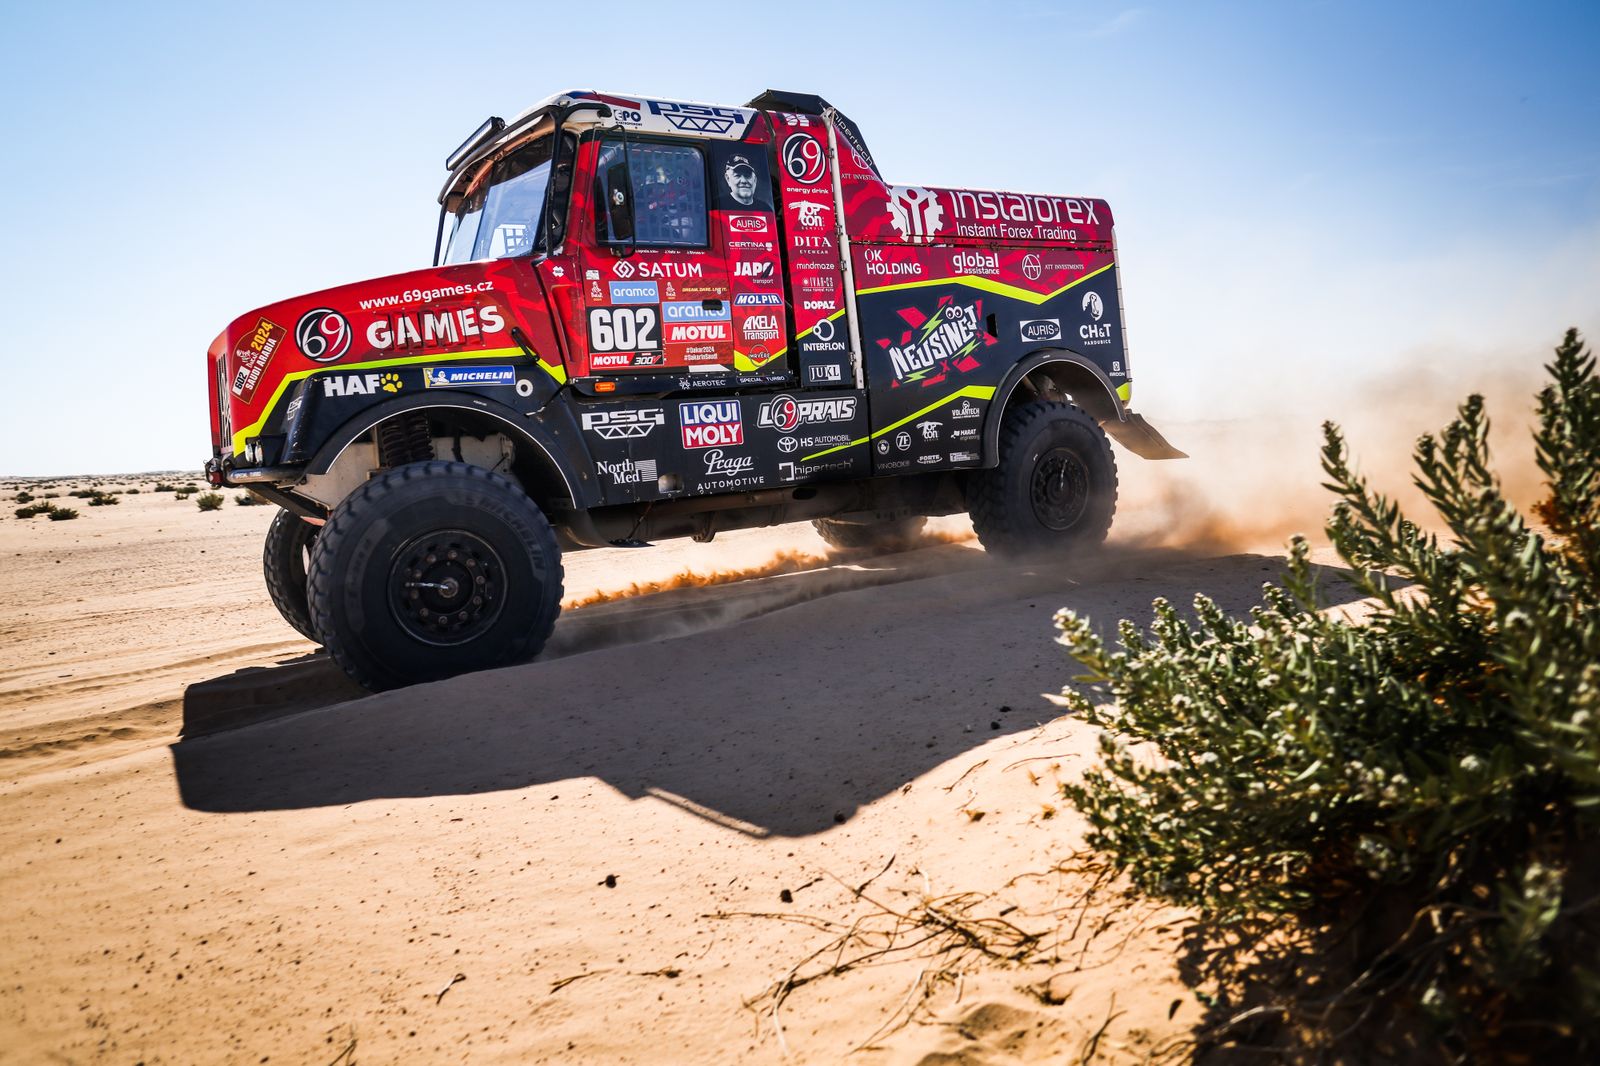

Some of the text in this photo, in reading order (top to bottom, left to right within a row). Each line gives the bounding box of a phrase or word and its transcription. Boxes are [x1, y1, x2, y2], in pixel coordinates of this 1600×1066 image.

[788, 140, 821, 178] 69
[736, 219, 761, 229] AURIS
[957, 222, 1077, 241] Instant Forex Trading
[794, 236, 832, 248] DITA
[638, 262, 702, 278] SATUM
[796, 262, 835, 270] mindmaze
[866, 263, 921, 275] HOLDING
[952, 252, 999, 274] global
[964, 266, 1000, 275] assistance
[359, 281, 494, 310] www.69games.cz
[613, 285, 656, 297] aramco
[737, 295, 780, 304] MOLPIR
[803, 301, 836, 310] DOPAZ
[366, 305, 505, 349] GAMES
[590, 308, 658, 351] 602
[743, 315, 779, 330] AKELA
[1027, 324, 1055, 336] AURIS
[251, 321, 273, 351] 2024
[302, 313, 345, 357] 69
[672, 325, 726, 340] MOTUL
[744, 329, 779, 341] Transport
[1080, 323, 1111, 338] CH&T
[803, 342, 845, 352] INTERFLON
[245, 338, 277, 391] SAUDI ARABIA
[593, 355, 630, 366] MOTUL
[235, 372, 247, 389] 602
[450, 371, 514, 381] MICHELIN
[811, 366, 840, 380] JUKL
[324, 374, 380, 397] HAF
[683, 402, 739, 425] LIQUI
[685, 424, 740, 446] MOLY
[800, 437, 813, 447] HS
[596, 459, 635, 475] North
[703, 449, 753, 477] Praga
[794, 460, 852, 474] hipertech
[613, 470, 640, 485] Med
[697, 475, 765, 490] AUTOMOTIVE
